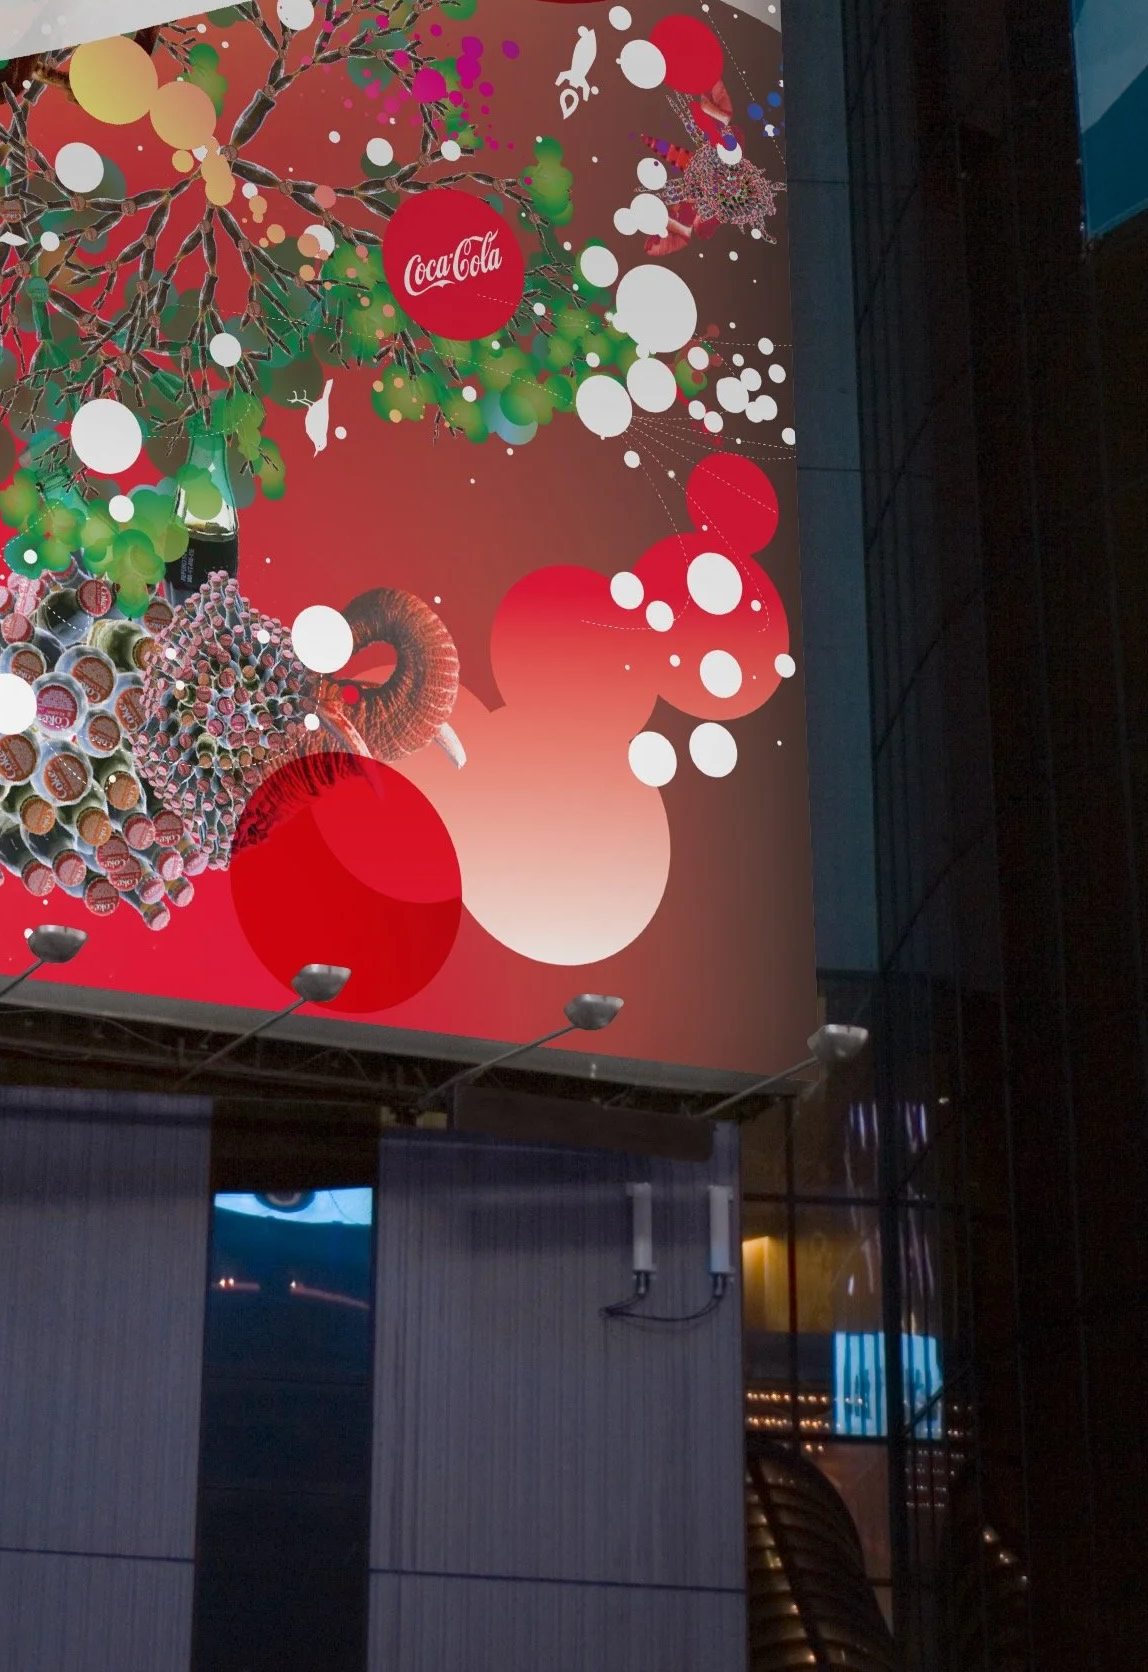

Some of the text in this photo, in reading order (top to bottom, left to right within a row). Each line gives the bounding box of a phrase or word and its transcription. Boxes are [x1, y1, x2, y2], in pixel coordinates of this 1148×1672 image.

[403, 228, 503, 297] Coca-Cola
[42, 713, 70, 727] Coke
[47, 771, 67, 798] Coke
